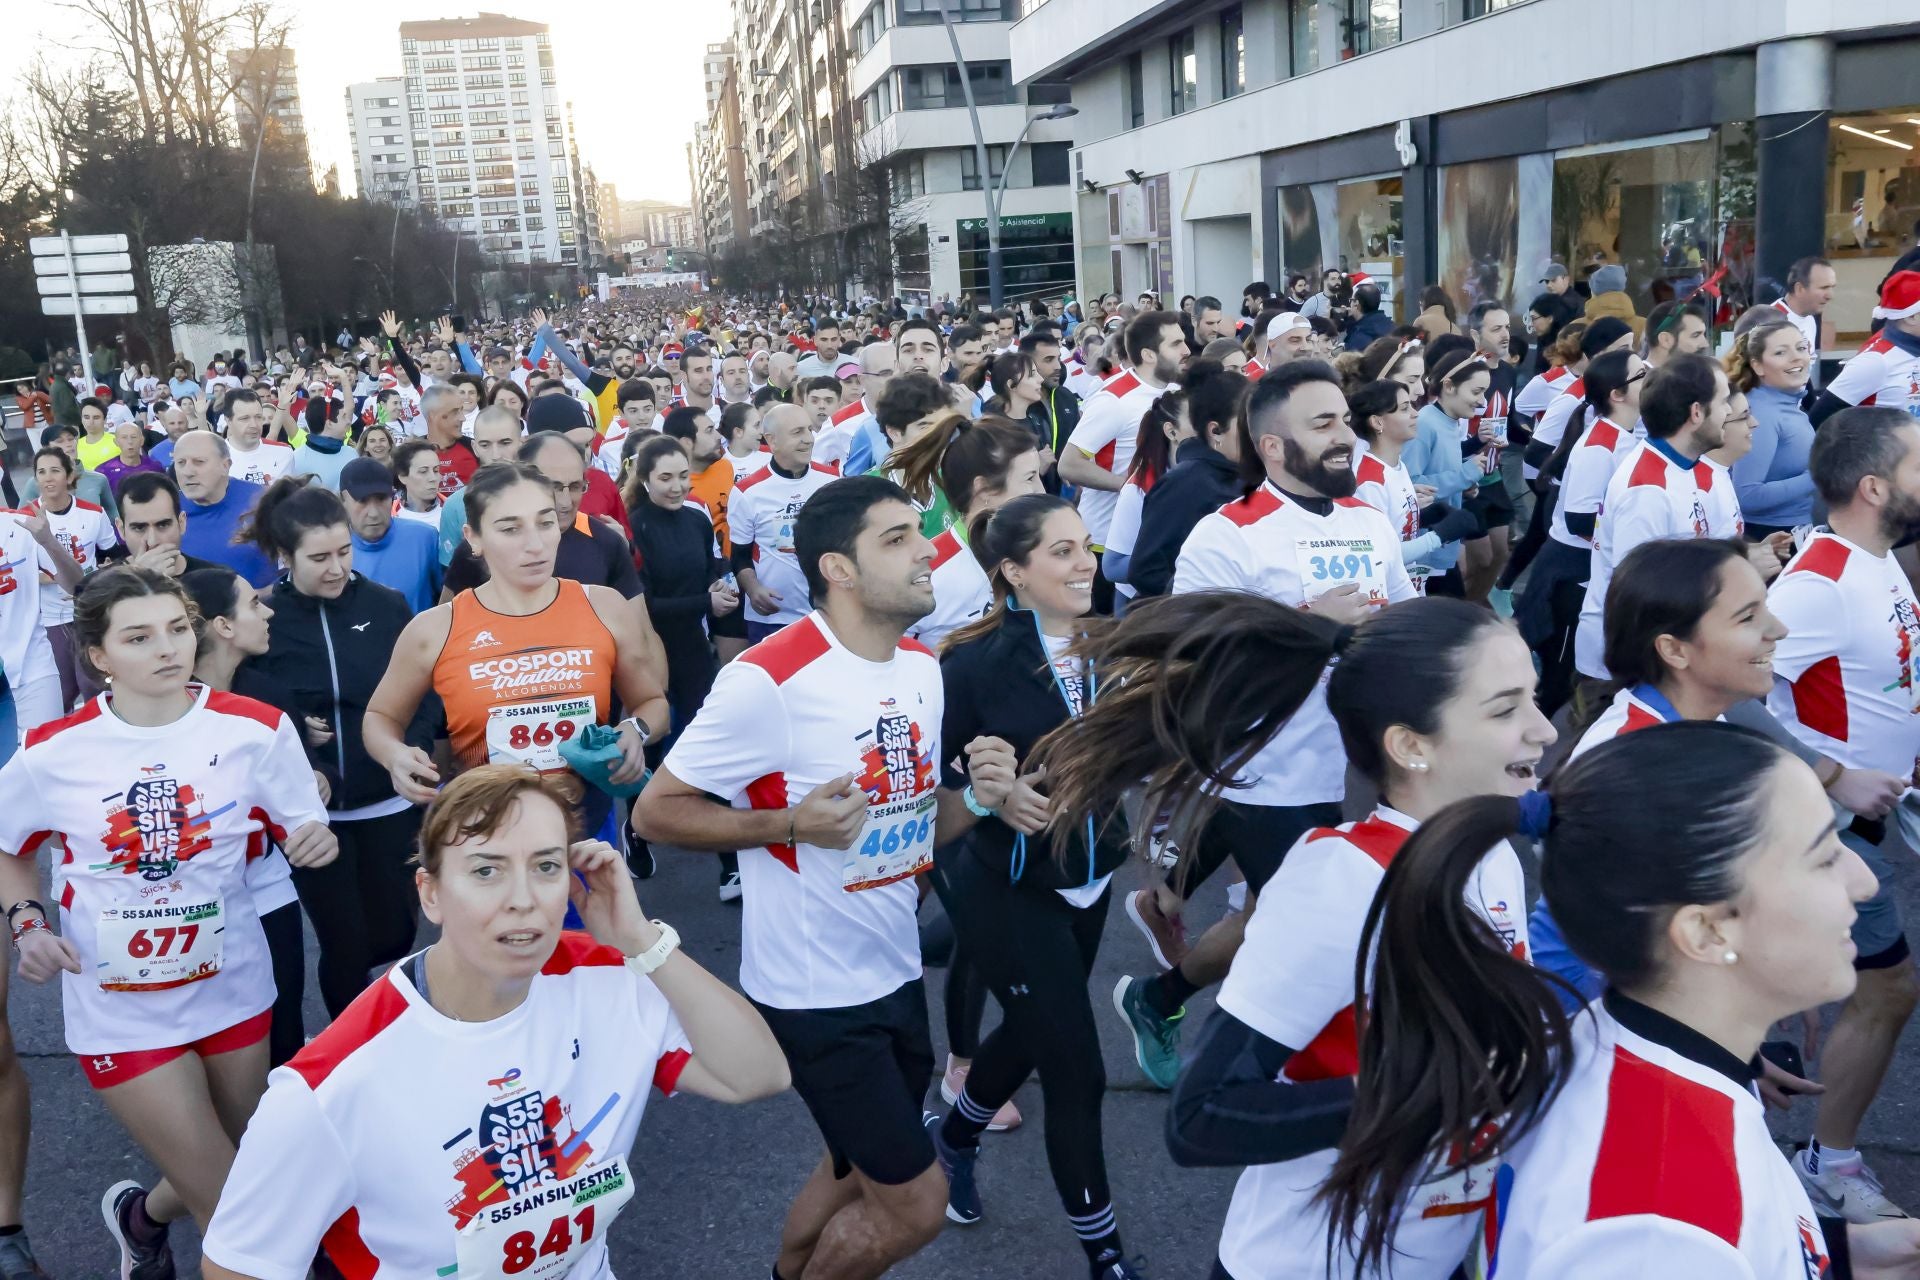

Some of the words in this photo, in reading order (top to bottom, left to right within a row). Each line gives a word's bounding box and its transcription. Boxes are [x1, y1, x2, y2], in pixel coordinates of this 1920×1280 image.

[1007, 216, 1046, 227] Asistencial
[1320, 540, 1337, 548] SAN
[1310, 554, 1373, 580] 3691
[469, 649, 593, 680] ECOSPORT
[490, 668, 583, 691] triatlón
[496, 682, 582, 698] ALCOBENDAS
[506, 708, 519, 717] 55
[520, 706, 540, 716] SAN
[541, 700, 590, 714] SILVESTRE
[510, 720, 575, 750] 869
[890, 717, 910, 736] 55
[882, 732, 912, 751] SAN
[886, 750, 913, 772] SIL
[149, 781, 177, 798] 55
[888, 769, 916, 792] VES
[135, 794, 177, 812] SAN
[874, 809, 886, 819] 55
[886, 804, 903, 816] SAN
[138, 811, 177, 832] SIL
[140, 828, 180, 851] VES
[860, 813, 930, 857] 4696
[122, 910, 137, 919] 55
[138, 909, 162, 919] SAN
[165, 901, 218, 917] SILVESTRE
[128, 924, 199, 958] 677
[507, 1094, 544, 1128] 55
[491, 1120, 544, 1154] SAN
[501, 1145, 548, 1185] SIL
[491, 1206, 512, 1223] 55
[513, 1193, 544, 1217] SAN
[547, 1163, 621, 1203] SILVESTRE
[602, 1178, 623, 1193] 2024
[502, 1204, 595, 1275] 841
[533, 1257, 565, 1274] MARIAN
